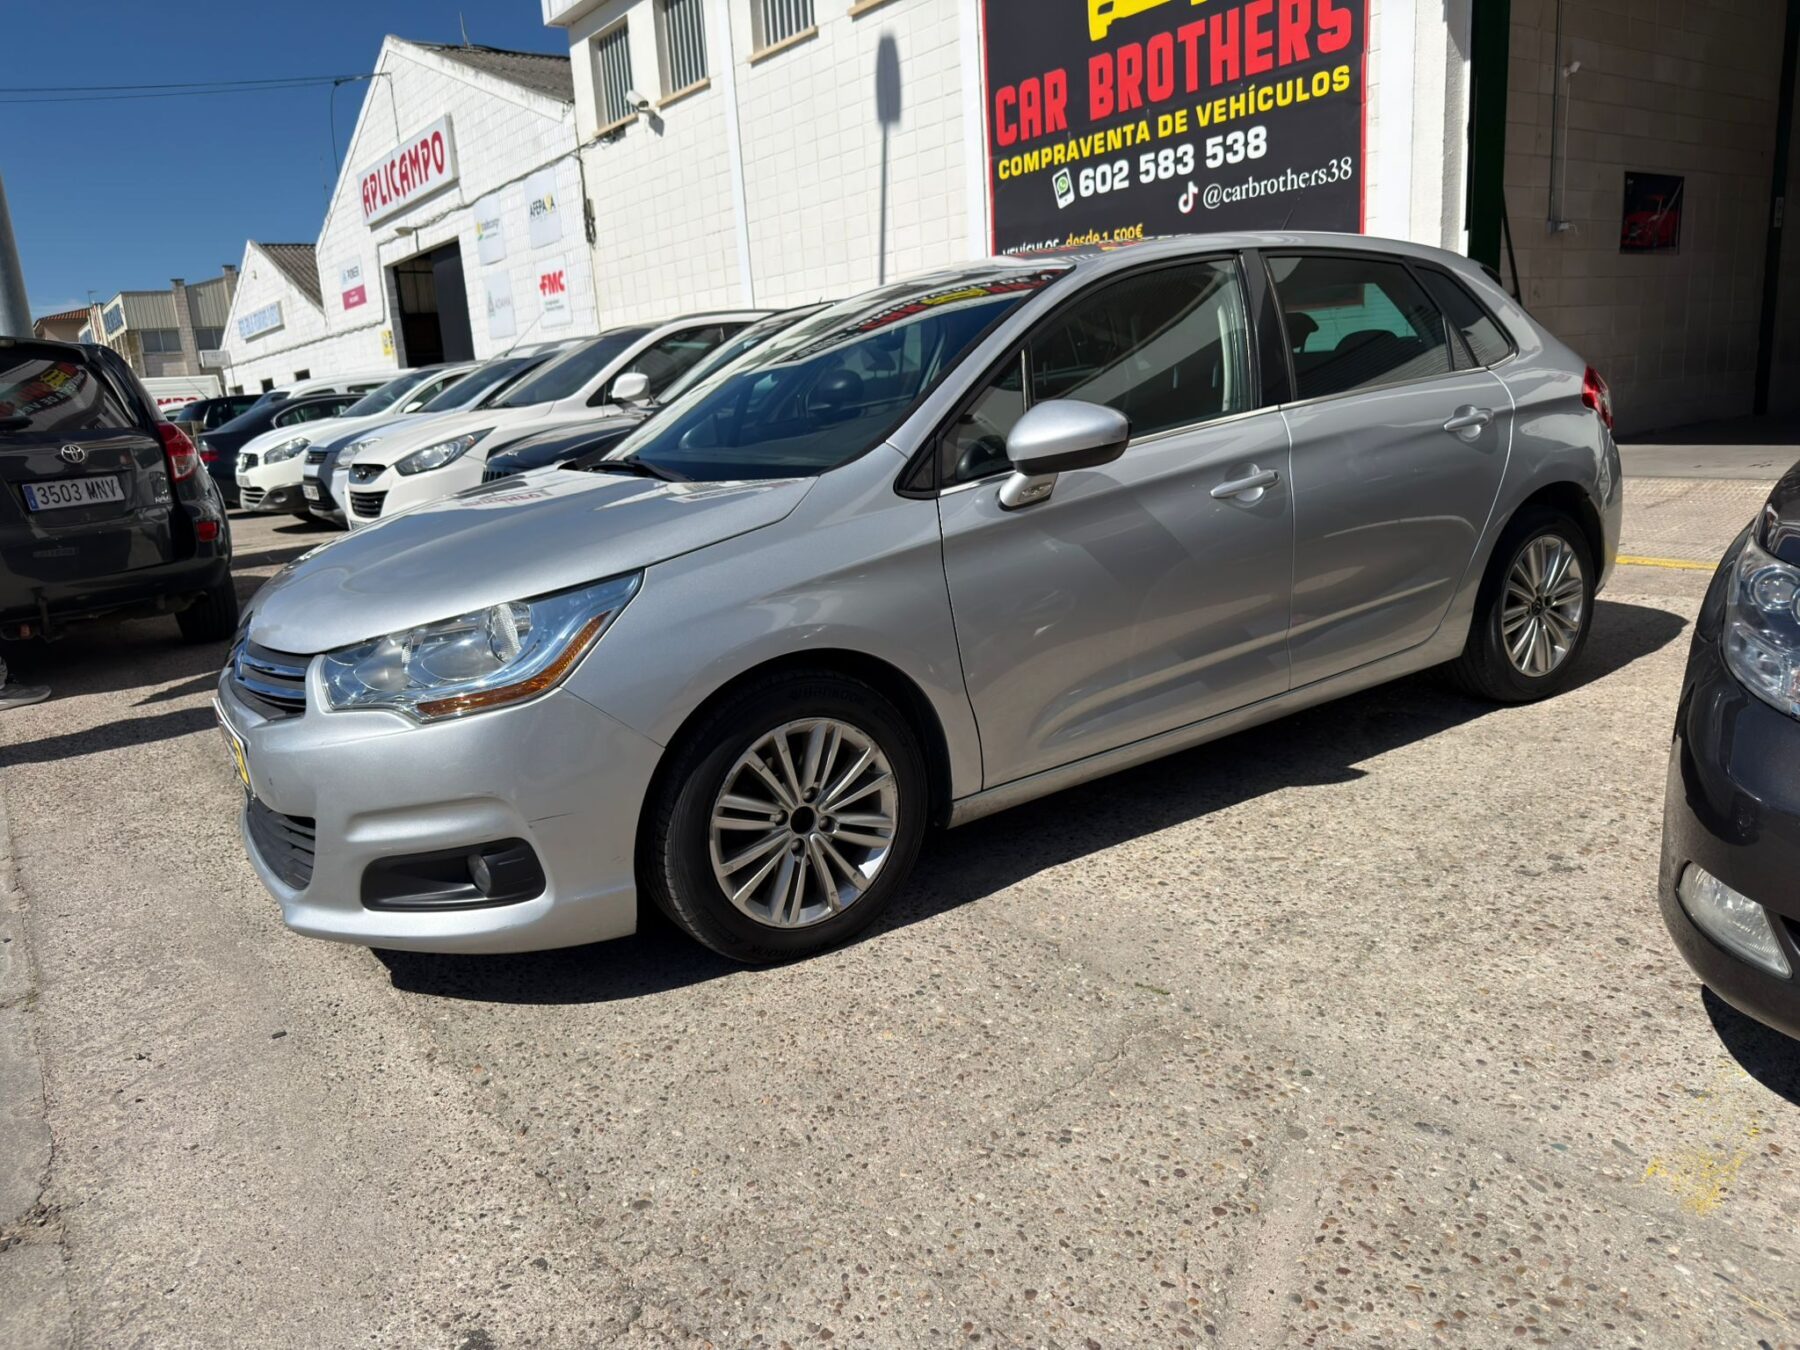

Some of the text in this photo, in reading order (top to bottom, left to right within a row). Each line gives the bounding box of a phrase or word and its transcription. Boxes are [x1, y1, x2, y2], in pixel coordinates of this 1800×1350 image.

[995, 0, 1353, 147] CAR BROTHERS
[998, 64, 1351, 181] COMPRAVENTA DE VEHÍCULOS
[362, 130, 445, 219] APLICAMPO
[1078, 125, 1268, 198] 602 583 538
[1202, 156, 1353, 210] @carbrothers38
[540, 270, 565, 296] FMC
[36, 479, 117, 506] 3503 MNV
